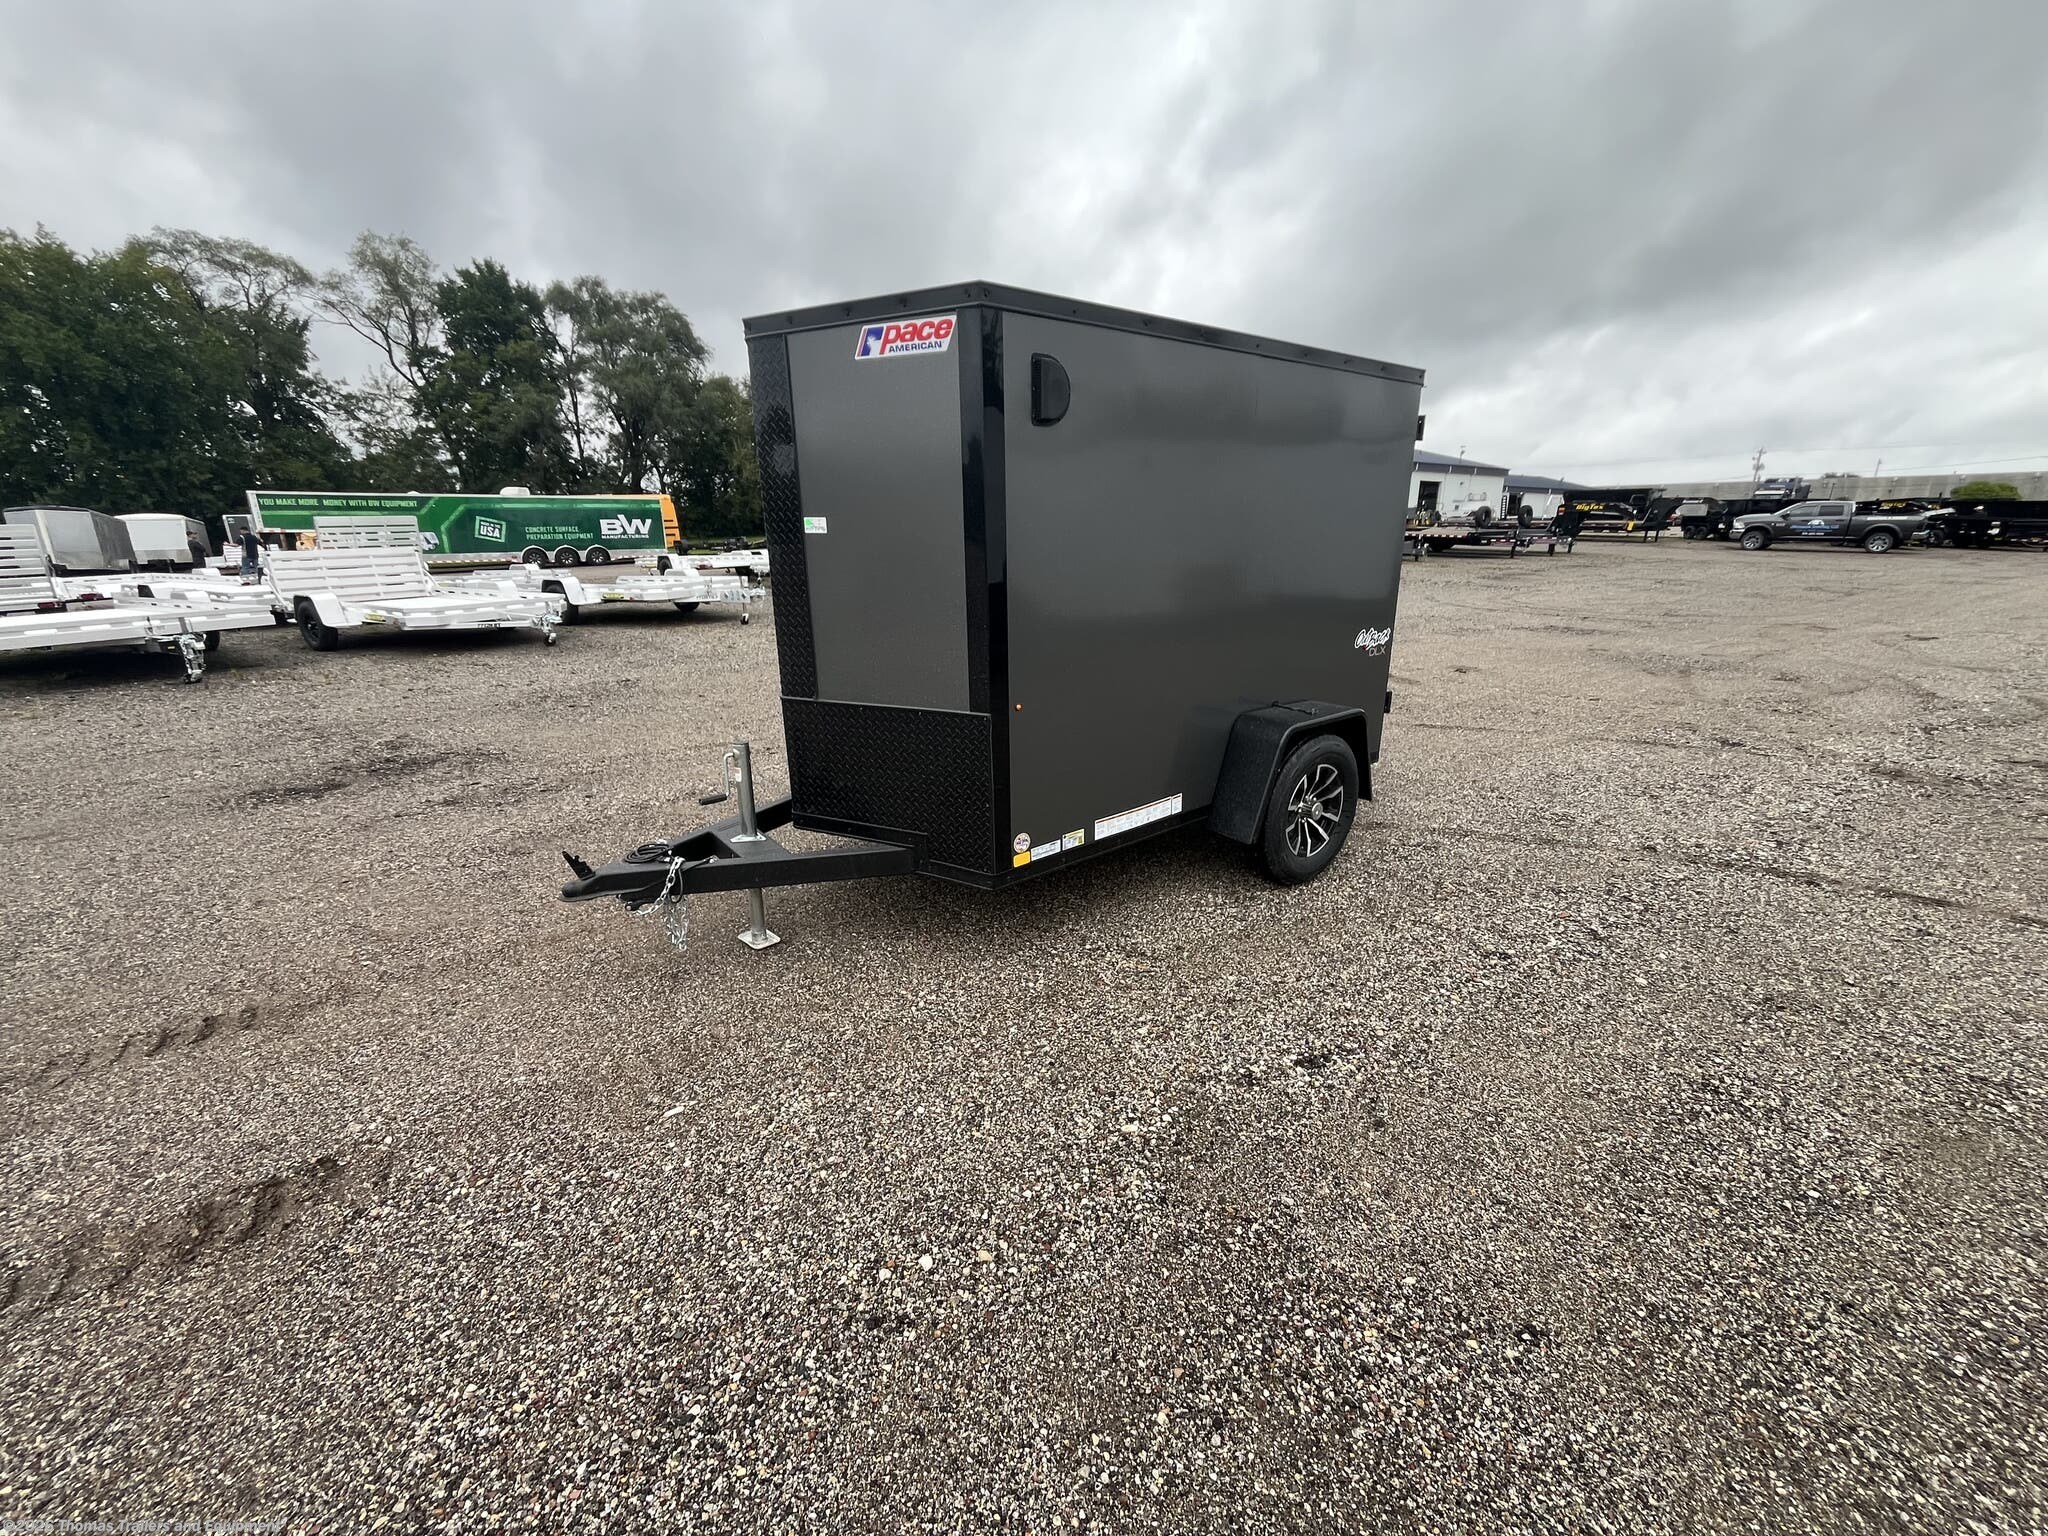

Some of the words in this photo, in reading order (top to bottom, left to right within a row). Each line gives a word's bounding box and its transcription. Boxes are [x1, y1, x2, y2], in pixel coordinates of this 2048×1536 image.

[879, 318, 953, 355] pace
[888, 340, 942, 353] AMERICAN
[258, 498, 275, 506] YOU
[275, 498, 298, 506] MAKE
[298, 498, 319, 506] MORE
[322, 499, 347, 507] MONEY
[348, 499, 367, 507] WITH
[381, 500, 418, 508] EQUIPMENT
[599, 514, 652, 535] BW
[480, 525, 500, 538] USA
[564, 532, 594, 540] EQUIPMENT
[1369, 645, 1386, 657] DLX
